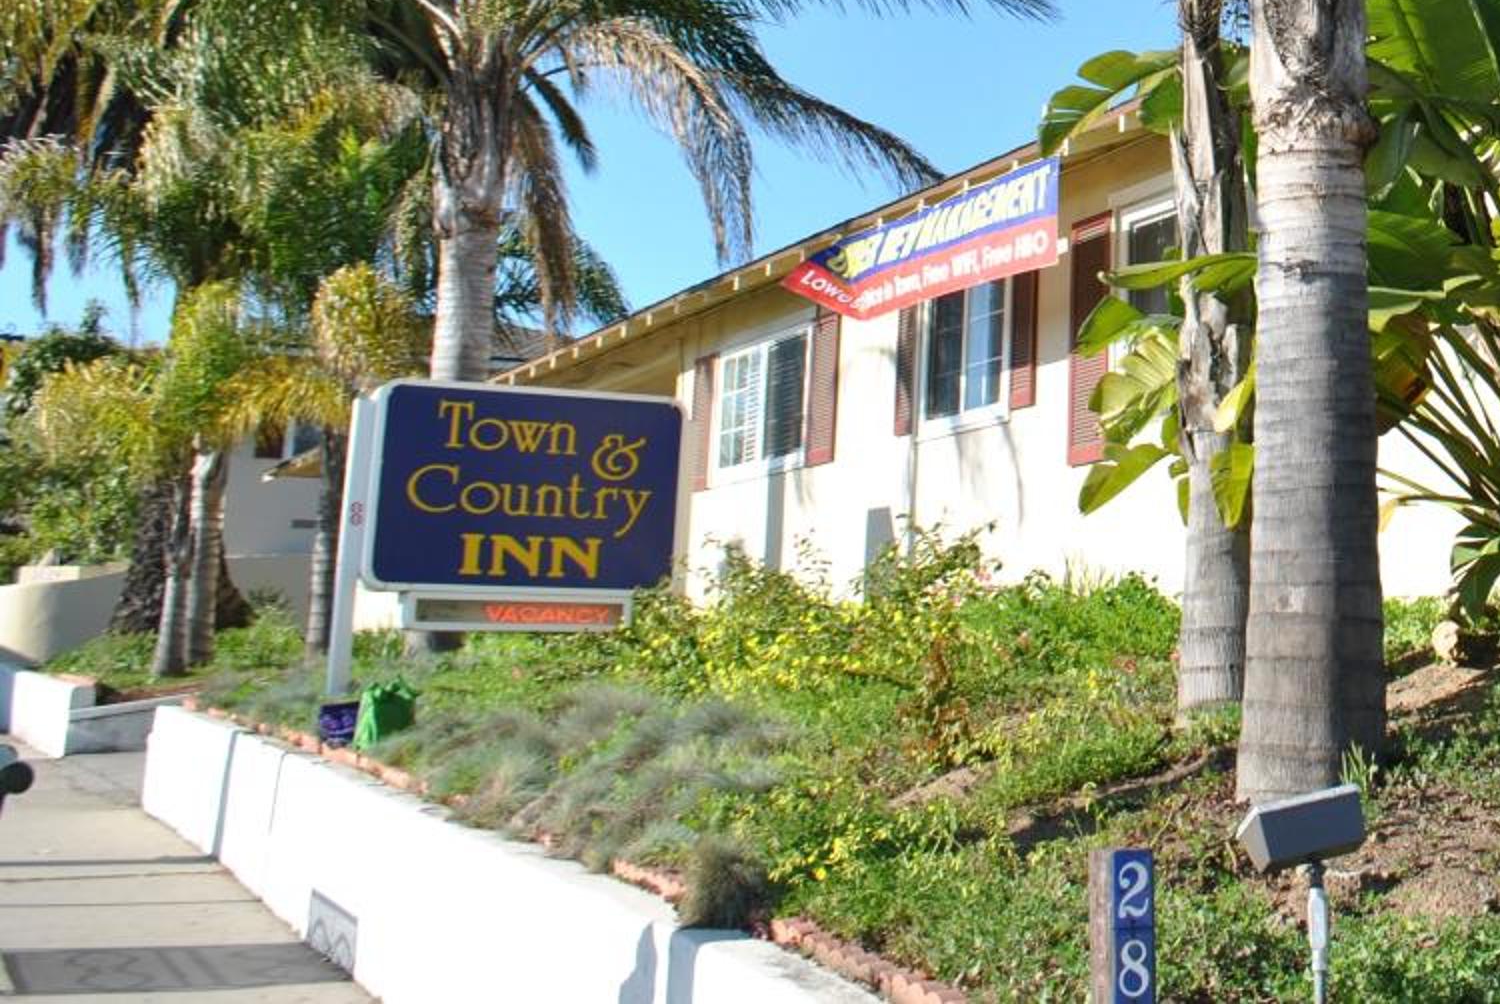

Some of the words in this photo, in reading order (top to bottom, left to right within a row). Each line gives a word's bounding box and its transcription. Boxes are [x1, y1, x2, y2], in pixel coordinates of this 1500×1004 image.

[982, 242, 1012, 269] Free
[1014, 229, 1048, 259] HBO
[438, 399, 577, 456] Town
[591, 434, 646, 481] &
[407, 463, 652, 538] Country
[459, 533, 602, 579] INN
[484, 603, 609, 625] VACANCY
